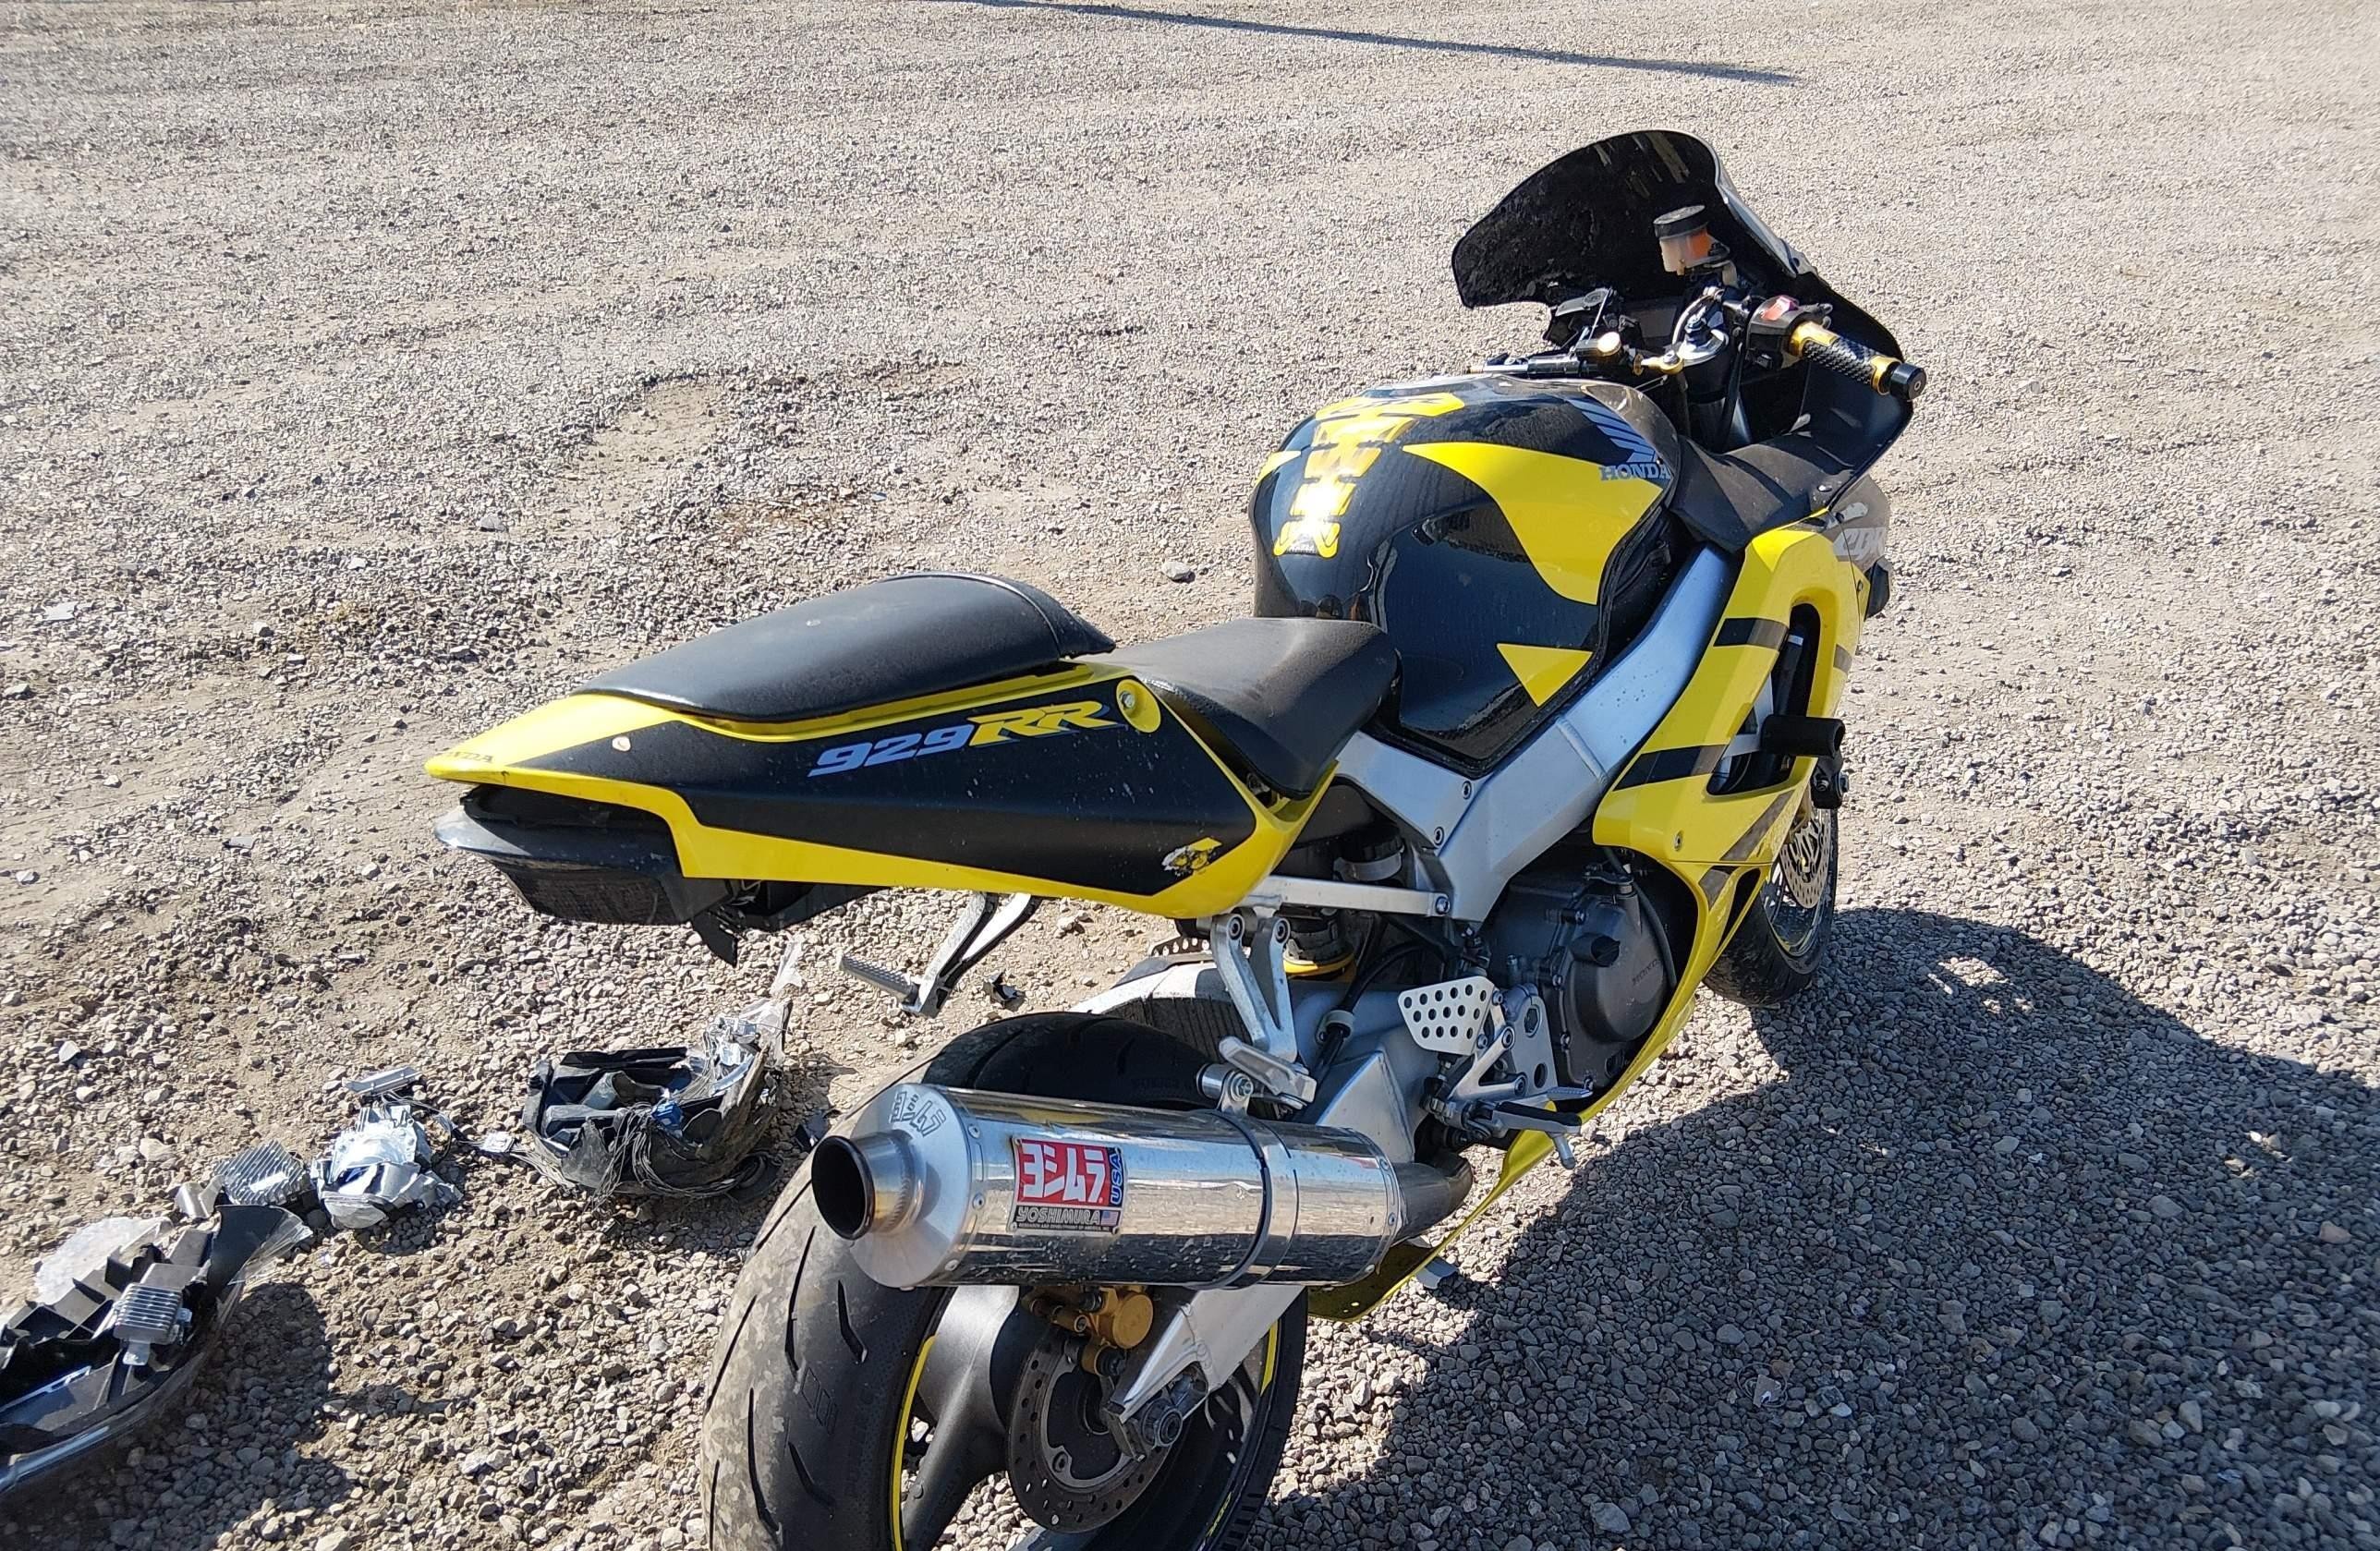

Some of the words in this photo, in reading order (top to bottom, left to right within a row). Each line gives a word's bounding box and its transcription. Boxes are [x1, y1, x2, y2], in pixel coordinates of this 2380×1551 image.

[1599, 463, 1671, 481] HONDA
[1021, 1142, 1106, 1204] ヨシムラ
[1109, 1153, 1124, 1206] USA
[1016, 1206, 1100, 1226] YOSHIMURA
